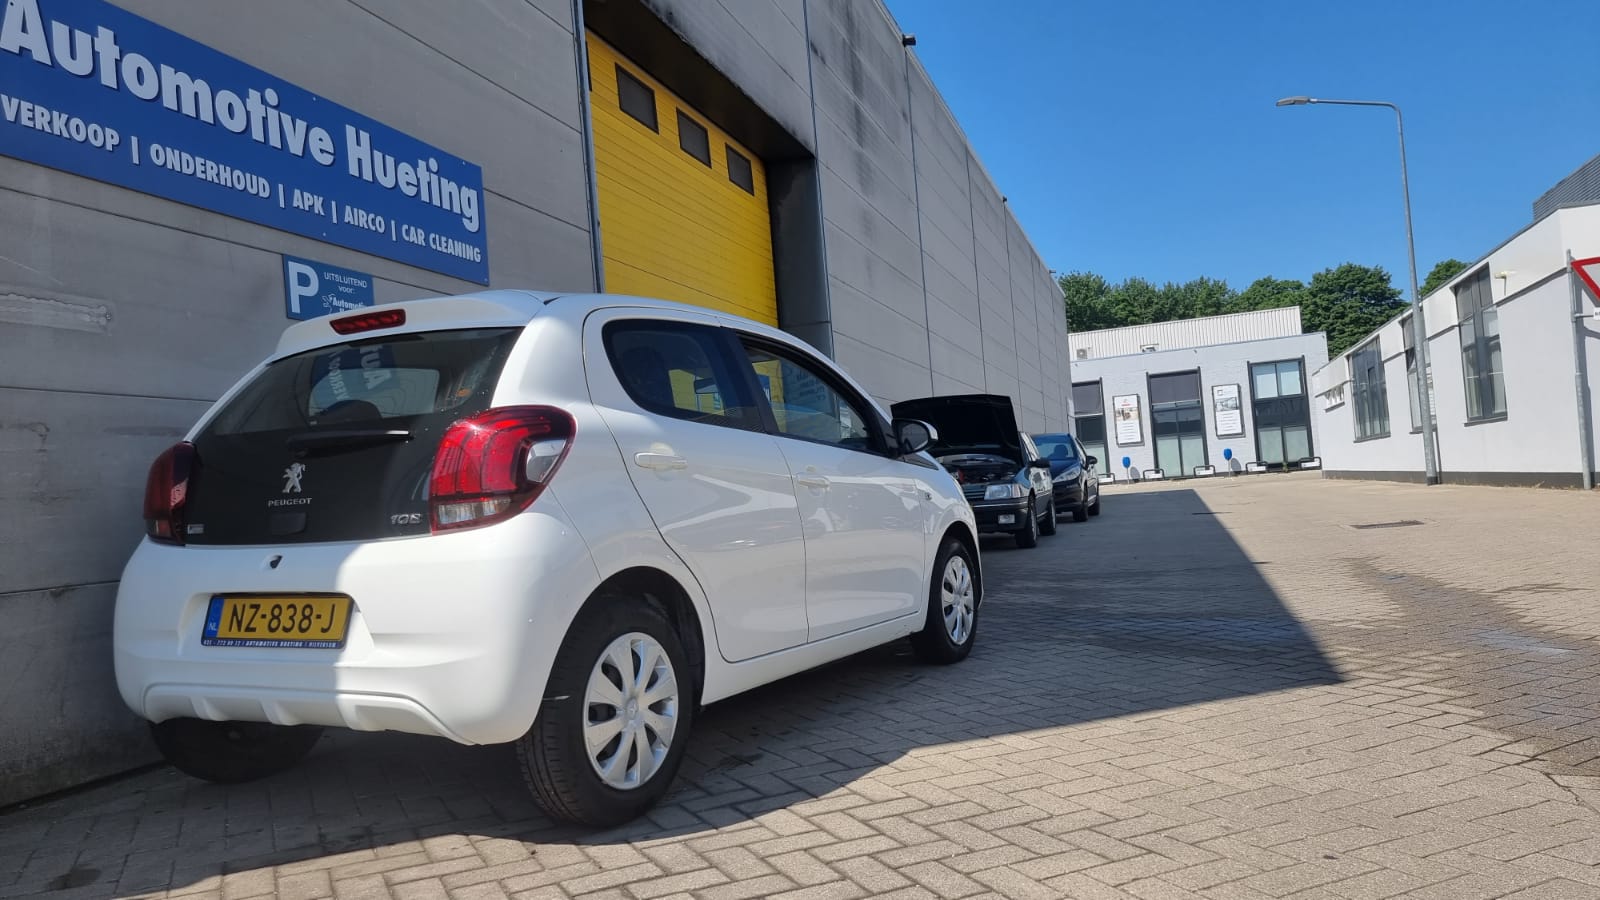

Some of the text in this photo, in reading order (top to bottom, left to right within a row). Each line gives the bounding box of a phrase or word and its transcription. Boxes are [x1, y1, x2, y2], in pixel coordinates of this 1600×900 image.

[0, 0, 480, 232] Automotive Hueting
[1, 93, 120, 152] VERKOOP
[150, 143, 271, 198] ONDERHOUD
[292, 189, 325, 216] APK
[344, 205, 385, 235] AIRCO
[402, 224, 426, 247] CAR
[429, 233, 481, 262] CLEANING
[288, 261, 319, 313] P
[323, 272, 368, 288] UITSLUITEND
[268, 498, 312, 507] PEUGEOT
[208, 621, 217, 632] NL
[228, 603, 336, 633] NZ-838-J
